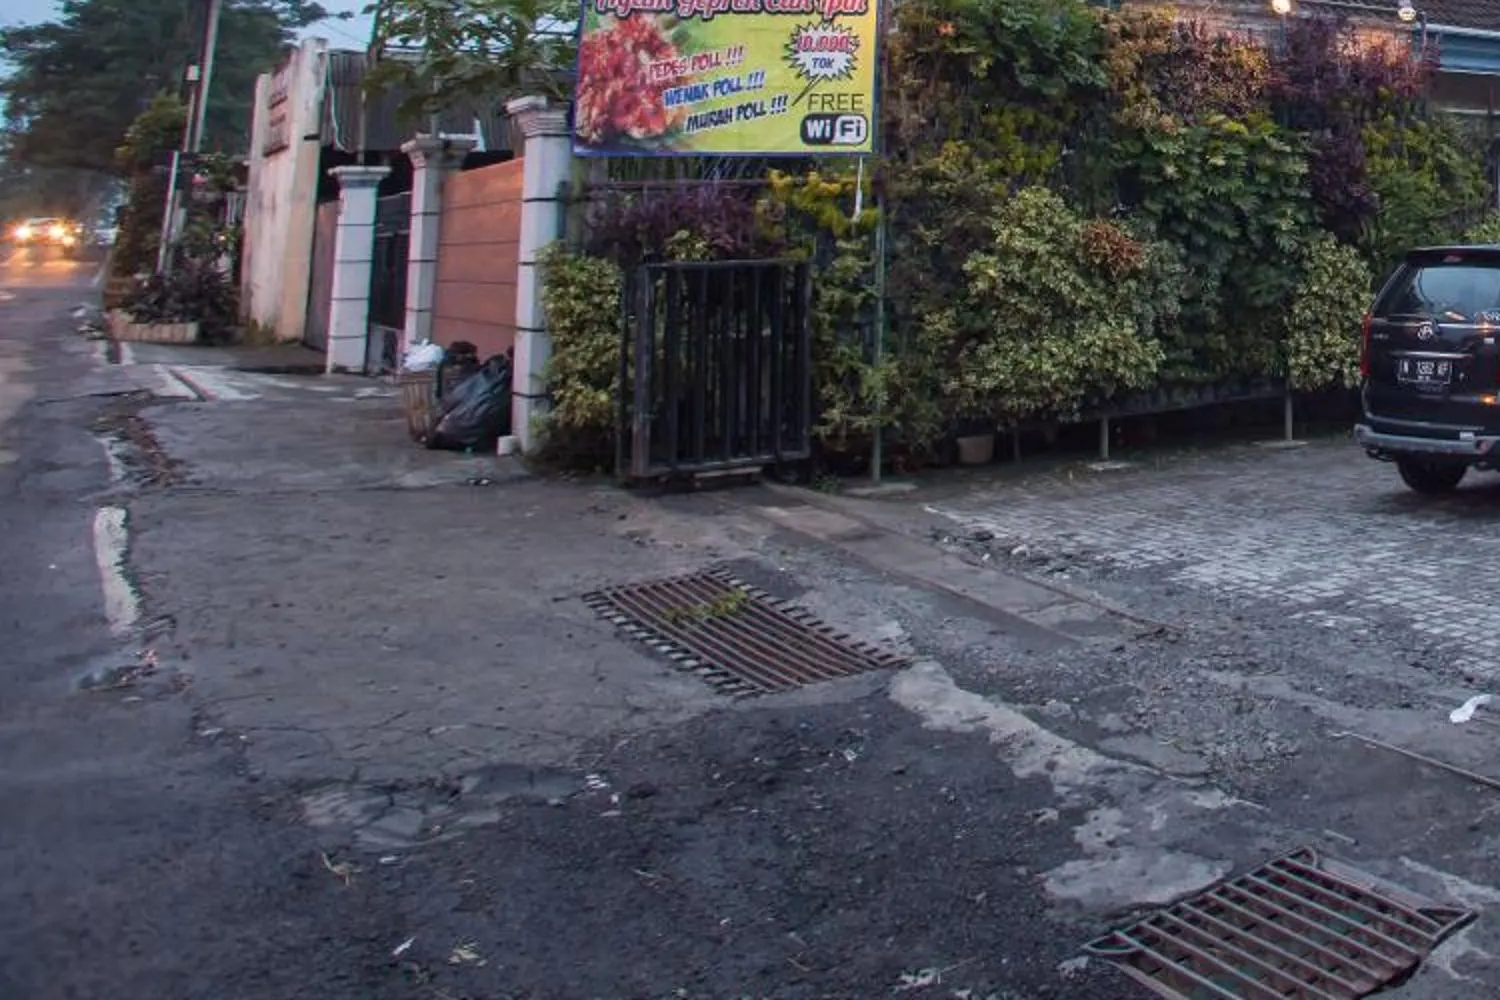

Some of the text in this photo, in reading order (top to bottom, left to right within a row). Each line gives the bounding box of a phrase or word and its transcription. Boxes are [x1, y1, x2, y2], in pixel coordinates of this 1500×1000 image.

[691, 51, 722, 71] POLL
[713, 77, 743, 97] POLL
[808, 93, 864, 112] FREE
[685, 107, 733, 132] MURAH
[735, 101, 767, 121] POLL
